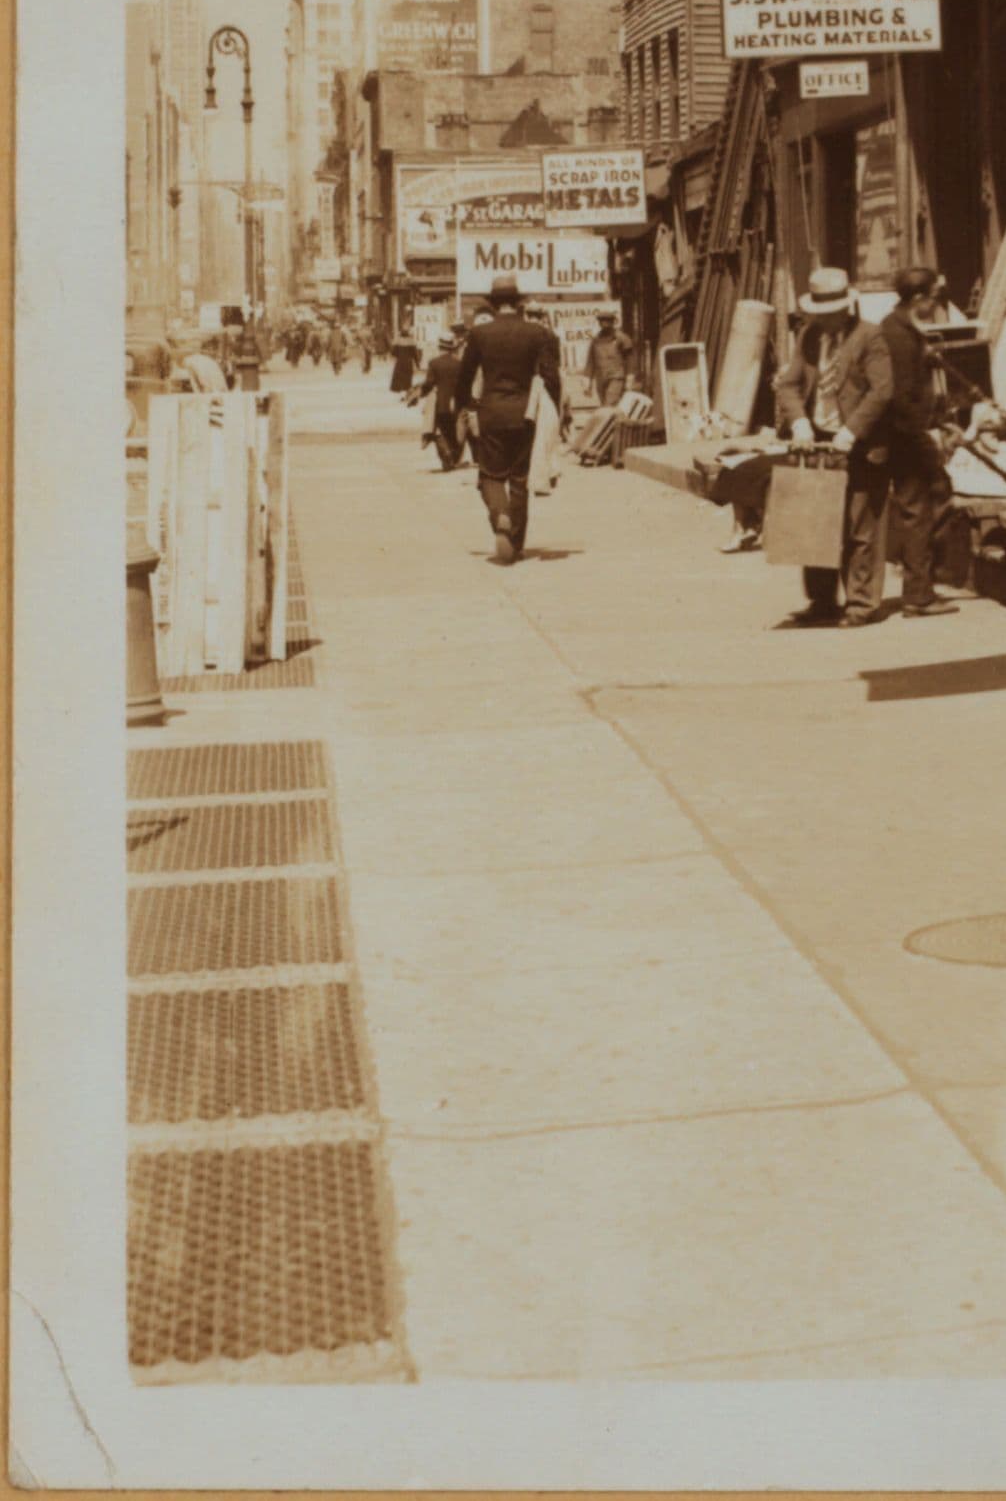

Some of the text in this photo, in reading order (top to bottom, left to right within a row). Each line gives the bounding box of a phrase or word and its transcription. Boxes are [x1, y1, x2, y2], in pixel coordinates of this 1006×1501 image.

[757, 7, 906, 29] PLUMBING &
[734, 28, 933, 49] HEATING MATERIALS
[804, 72, 862, 87] OFFICE
[549, 170, 641, 185] SCRAP IRON
[546, 186, 640, 211] METALS
